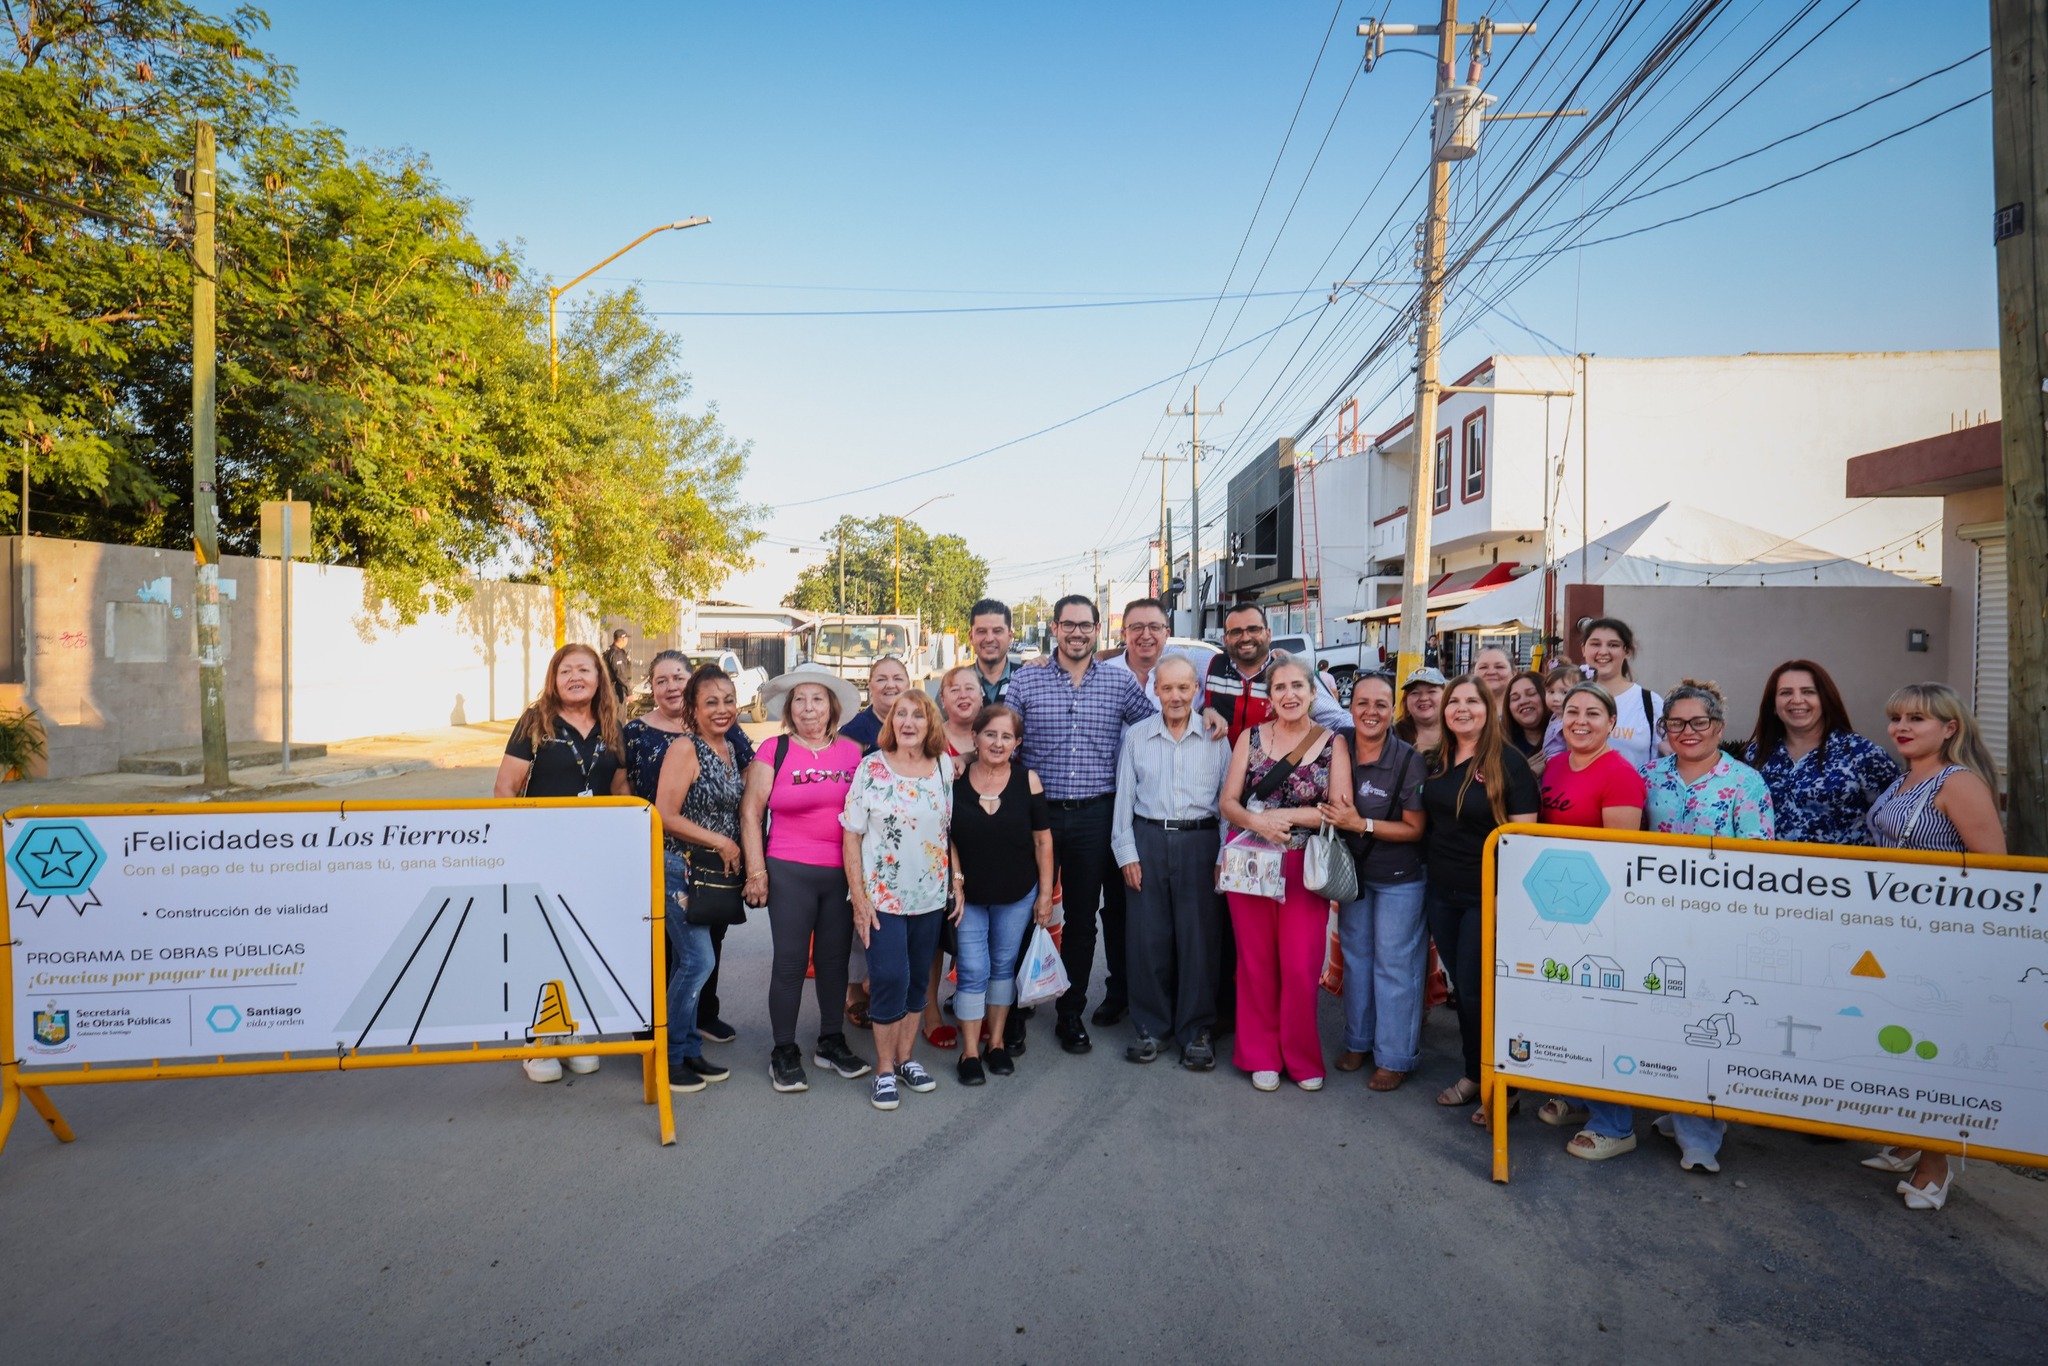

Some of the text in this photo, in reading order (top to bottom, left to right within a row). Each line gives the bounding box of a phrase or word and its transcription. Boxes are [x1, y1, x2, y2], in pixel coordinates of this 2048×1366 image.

[124, 823, 490, 857] ¡Felicidades a Los Fierros!
[123, 855, 505, 878] Con el pago de tu predial ganas tú, gana Santiago
[1626, 855, 2042, 914] ¡Felicidades Vecinos!
[155, 903, 328, 919] Construcción de vialidad
[1623, 890, 1655, 906] Con
[1661, 895, 1675, 908] el
[1680, 898, 1721, 914] pago
[1726, 900, 1748, 914] de
[1753, 902, 1769, 916] tu
[1775, 906, 1833, 922] predial
[1840, 912, 1894, 927] ganas
[1900, 915, 1922, 932] tú,
[1929, 920, 1975, 934] gana
[27, 942, 305, 964] PROGRAMA DE OBRAS PÚBLICAS
[28, 961, 305, 989] ¡Gracias por pagar tu predial!
[76, 1007, 130, 1018] Secretaría
[76, 1016, 171, 1028] de Obras Públicas
[246, 1006, 302, 1017] Santiago
[246, 1017, 304, 1029] vida y orden
[1639, 1060, 1677, 1072] Santiago
[1727, 1064, 2002, 1112] PROGRAMA DE OBRAS PÚBLICAS
[1725, 1082, 1999, 1131] ¡Gracias por pagar tu predial!
